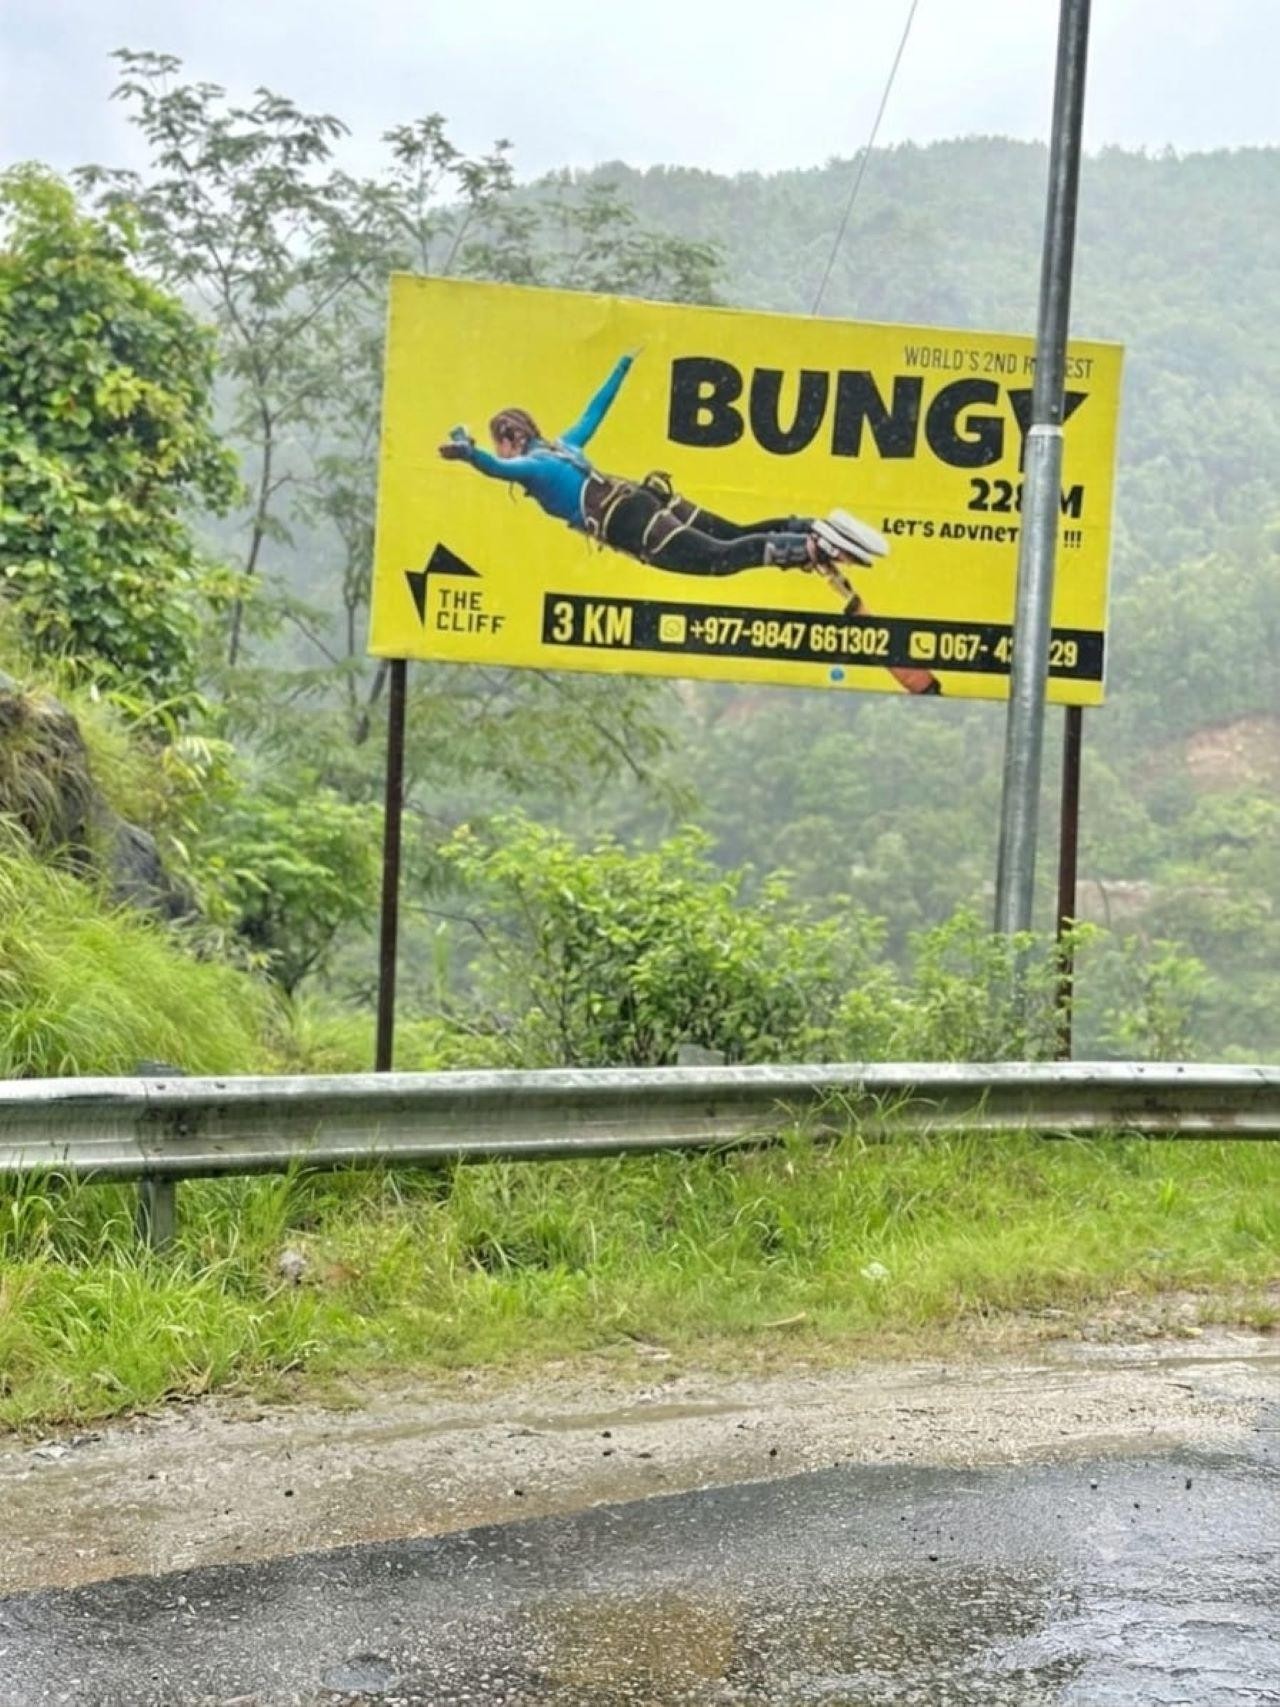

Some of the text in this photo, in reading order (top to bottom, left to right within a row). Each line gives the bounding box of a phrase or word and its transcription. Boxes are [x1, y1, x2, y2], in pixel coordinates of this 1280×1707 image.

[904, 344, 980, 371] WORLD'S
[983, 353, 1017, 373] 2ND
[668, 355, 1089, 473] BUNGY
[438, 589, 483, 611] THE
[436, 611, 506, 634] CLIFF
[552, 602, 633, 646] 3 KM
[690, 617, 890, 656] +977-9847 661302
[993, 636, 1078, 668] 429
